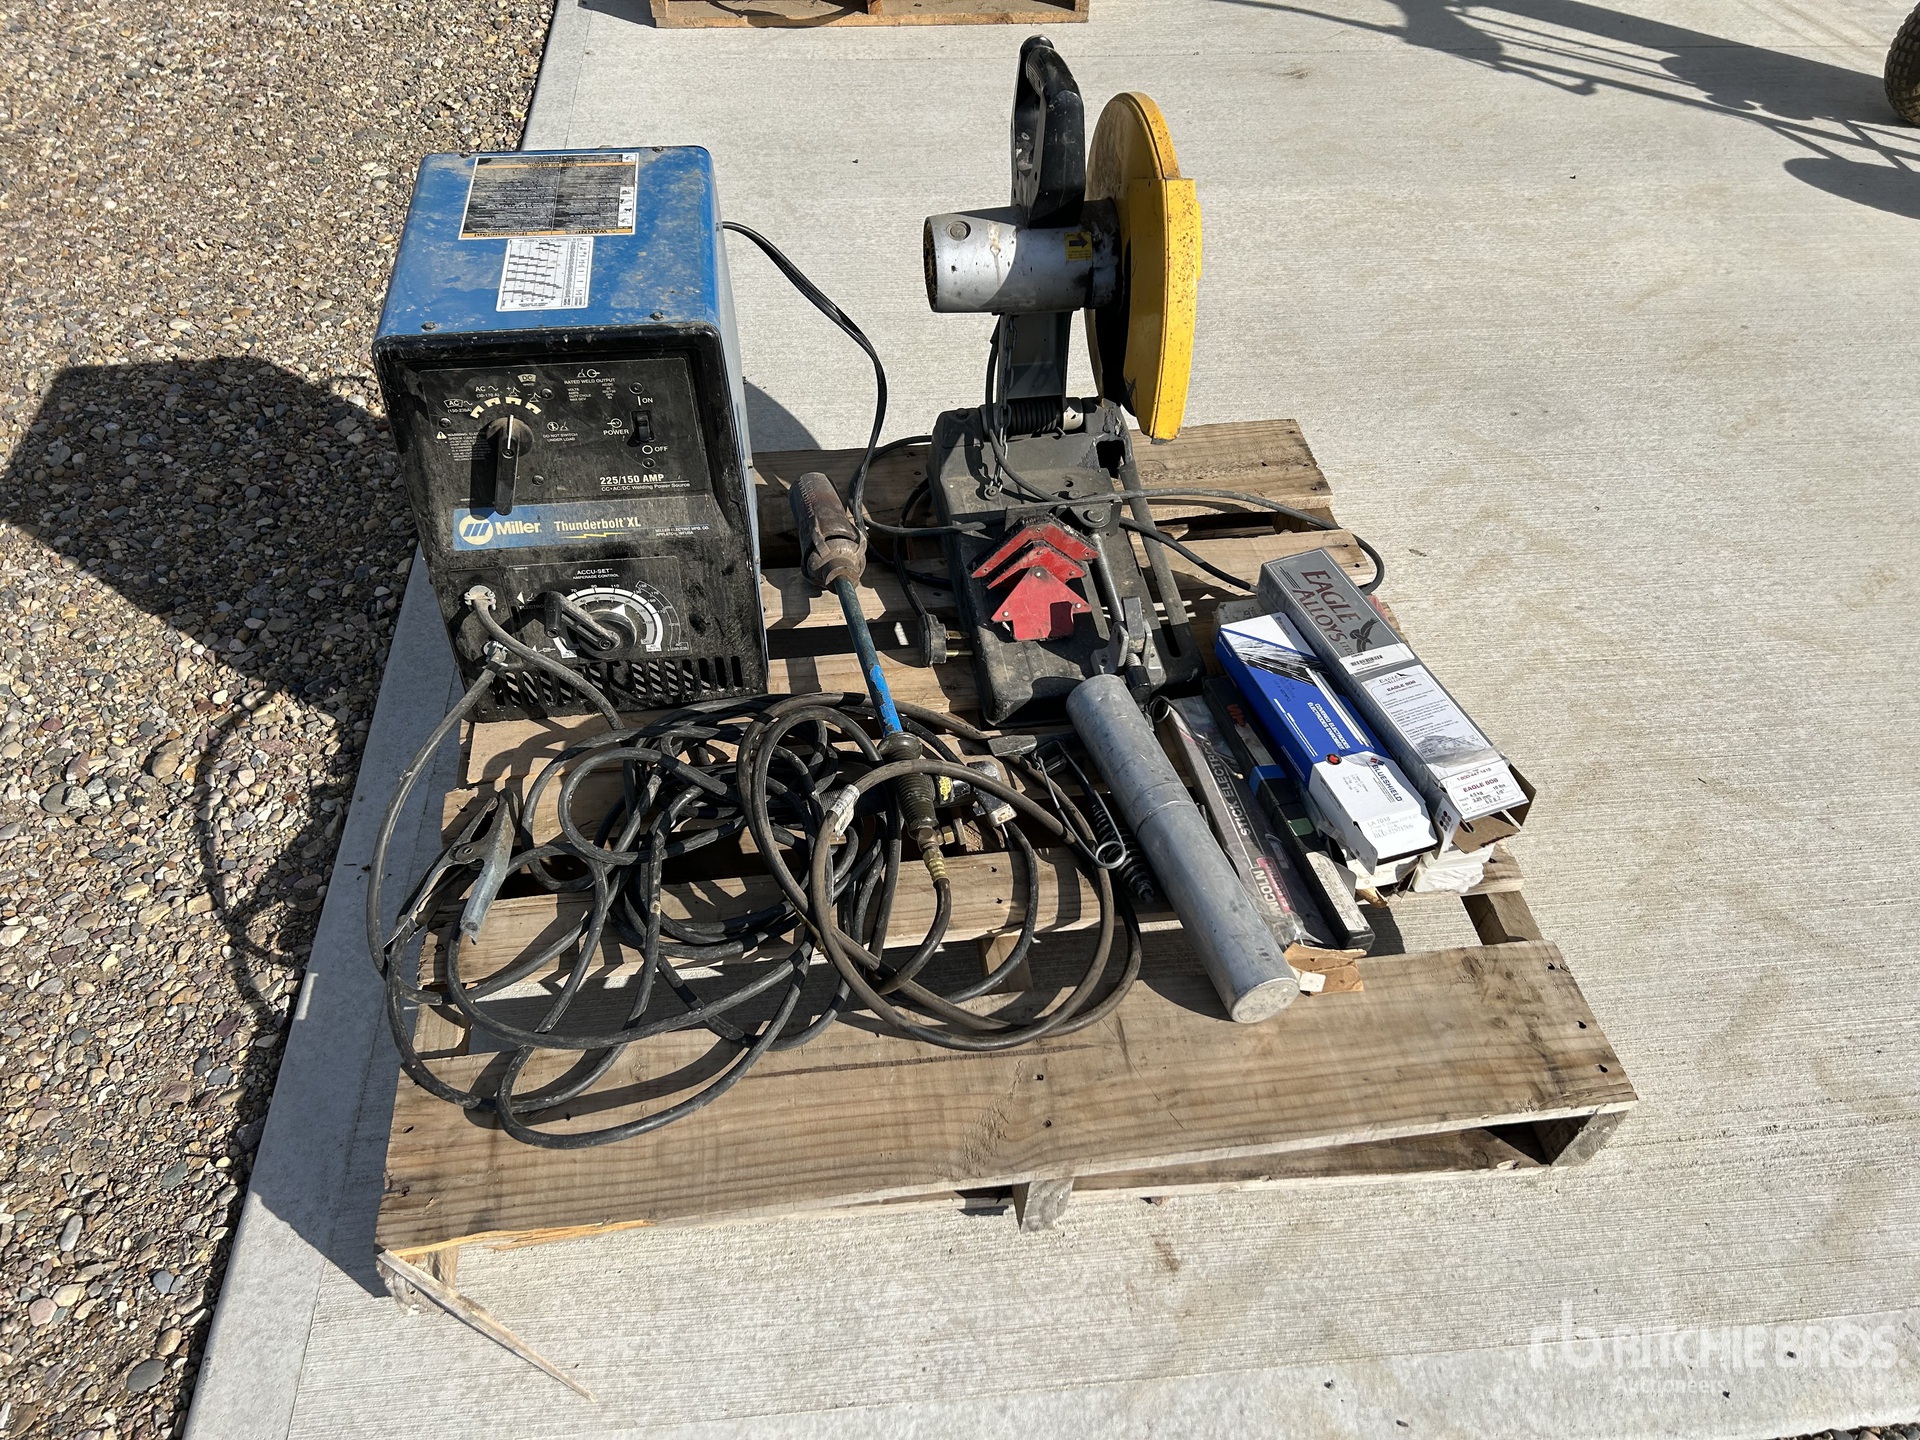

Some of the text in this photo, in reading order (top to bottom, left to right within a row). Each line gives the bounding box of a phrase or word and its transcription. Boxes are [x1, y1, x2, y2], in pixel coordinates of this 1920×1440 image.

[600, 473, 665, 485] 225/150 AMP
[495, 520, 541, 535] Miller
[554, 517, 642, 532] Thunderbolt XL
[1300, 570, 1362, 623] EAGLE
[1292, 589, 1348, 642] ALLOYS
[1371, 764, 1403, 802] BLUESHIELD
[1462, 782, 1485, 793] EAGLE
[1228, 800, 1252, 837] STICK
[1253, 869, 1286, 918] INCOLN
